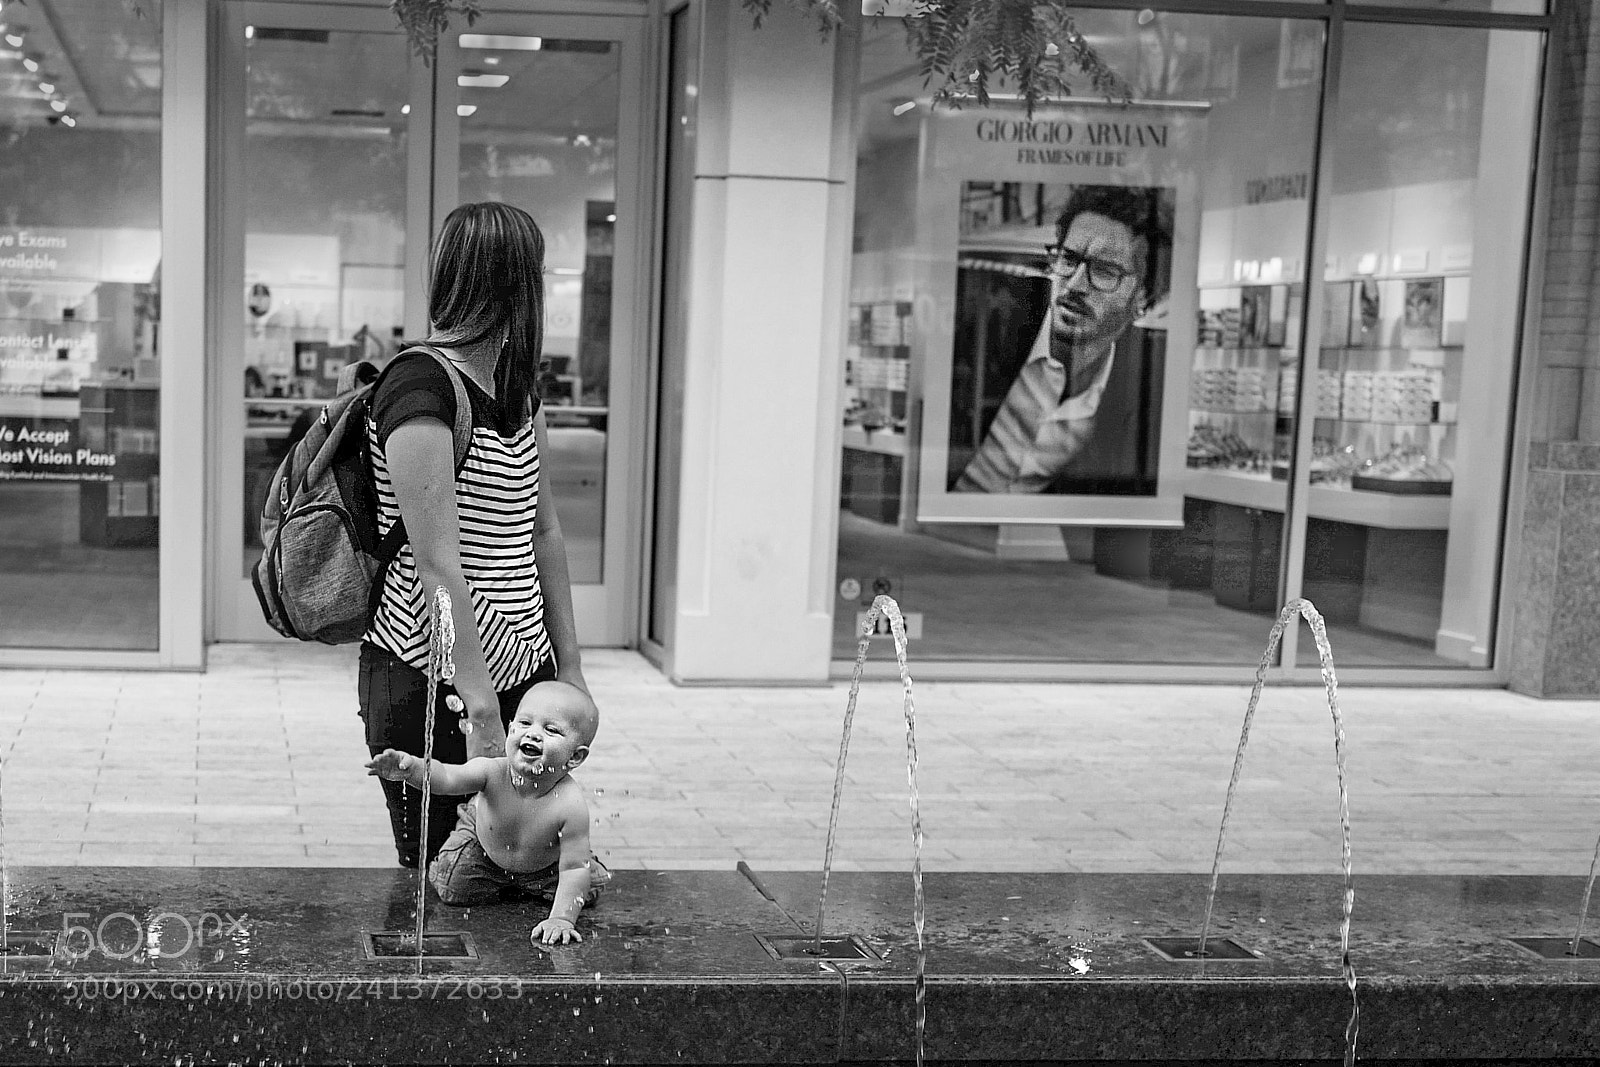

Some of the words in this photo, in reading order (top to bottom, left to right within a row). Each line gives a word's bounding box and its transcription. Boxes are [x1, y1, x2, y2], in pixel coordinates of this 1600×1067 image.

[976, 118, 1073, 144] GIORGIO
[1085, 122, 1169, 148] ARMANI
[1017, 148, 1073, 166] FRAMES
[1074, 149, 1093, 166] OF
[1096, 149, 1127, 167] LIFE
[18, 231, 67, 248] Exams
[17, 425, 70, 447] Accept
[0, 447, 24, 464] ost
[26, 446, 73, 465] Vision
[76, 447, 116, 467] Plans
